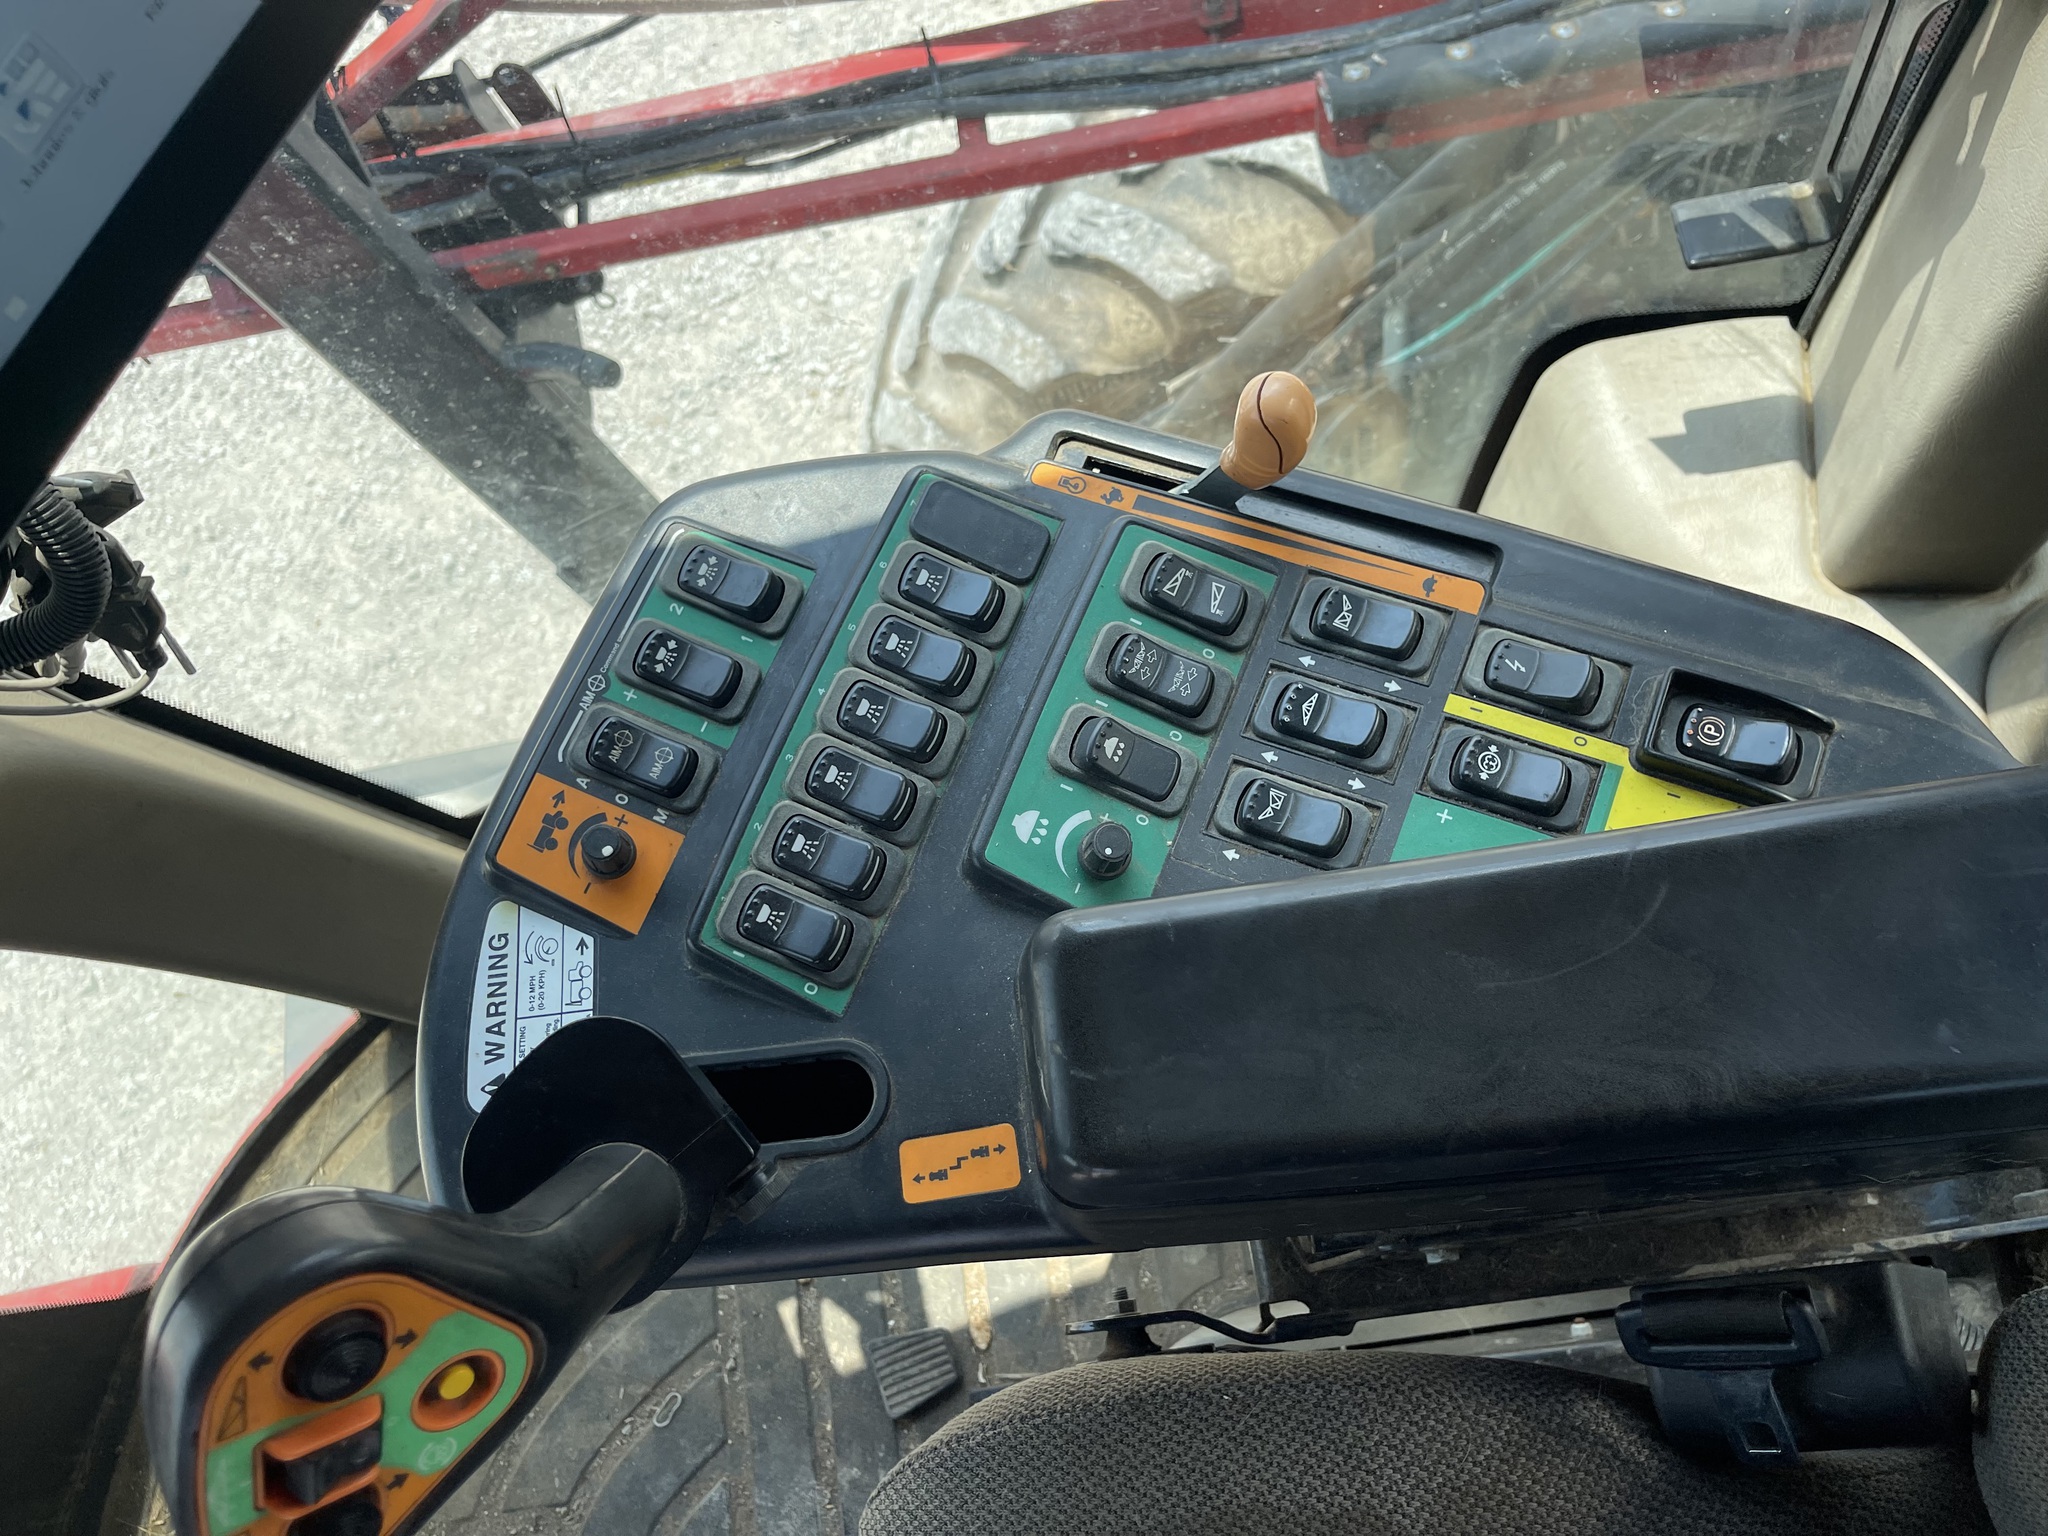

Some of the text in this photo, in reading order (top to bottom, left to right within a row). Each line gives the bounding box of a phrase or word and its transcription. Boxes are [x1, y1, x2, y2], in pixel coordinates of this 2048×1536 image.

[669, 603, 684, 615] 2
[847, 623, 857, 631] 5
[579, 642, 620, 711] AIM Command
[817, 687, 827, 695] 4
[608, 746, 624, 764] AIM
[785, 753, 794, 762] 3
[649, 762, 664, 780] AIM
[576, 778, 590, 789] A
[652, 808, 669, 824] M
[753, 822, 763, 831] 2
[484, 932, 509, 1065] WARNING
[528, 974, 537, 1012] 0-12 MPH
[537, 969, 547, 1011] (0-20 KPH)
[518, 1026, 527, 1058] SETTING
